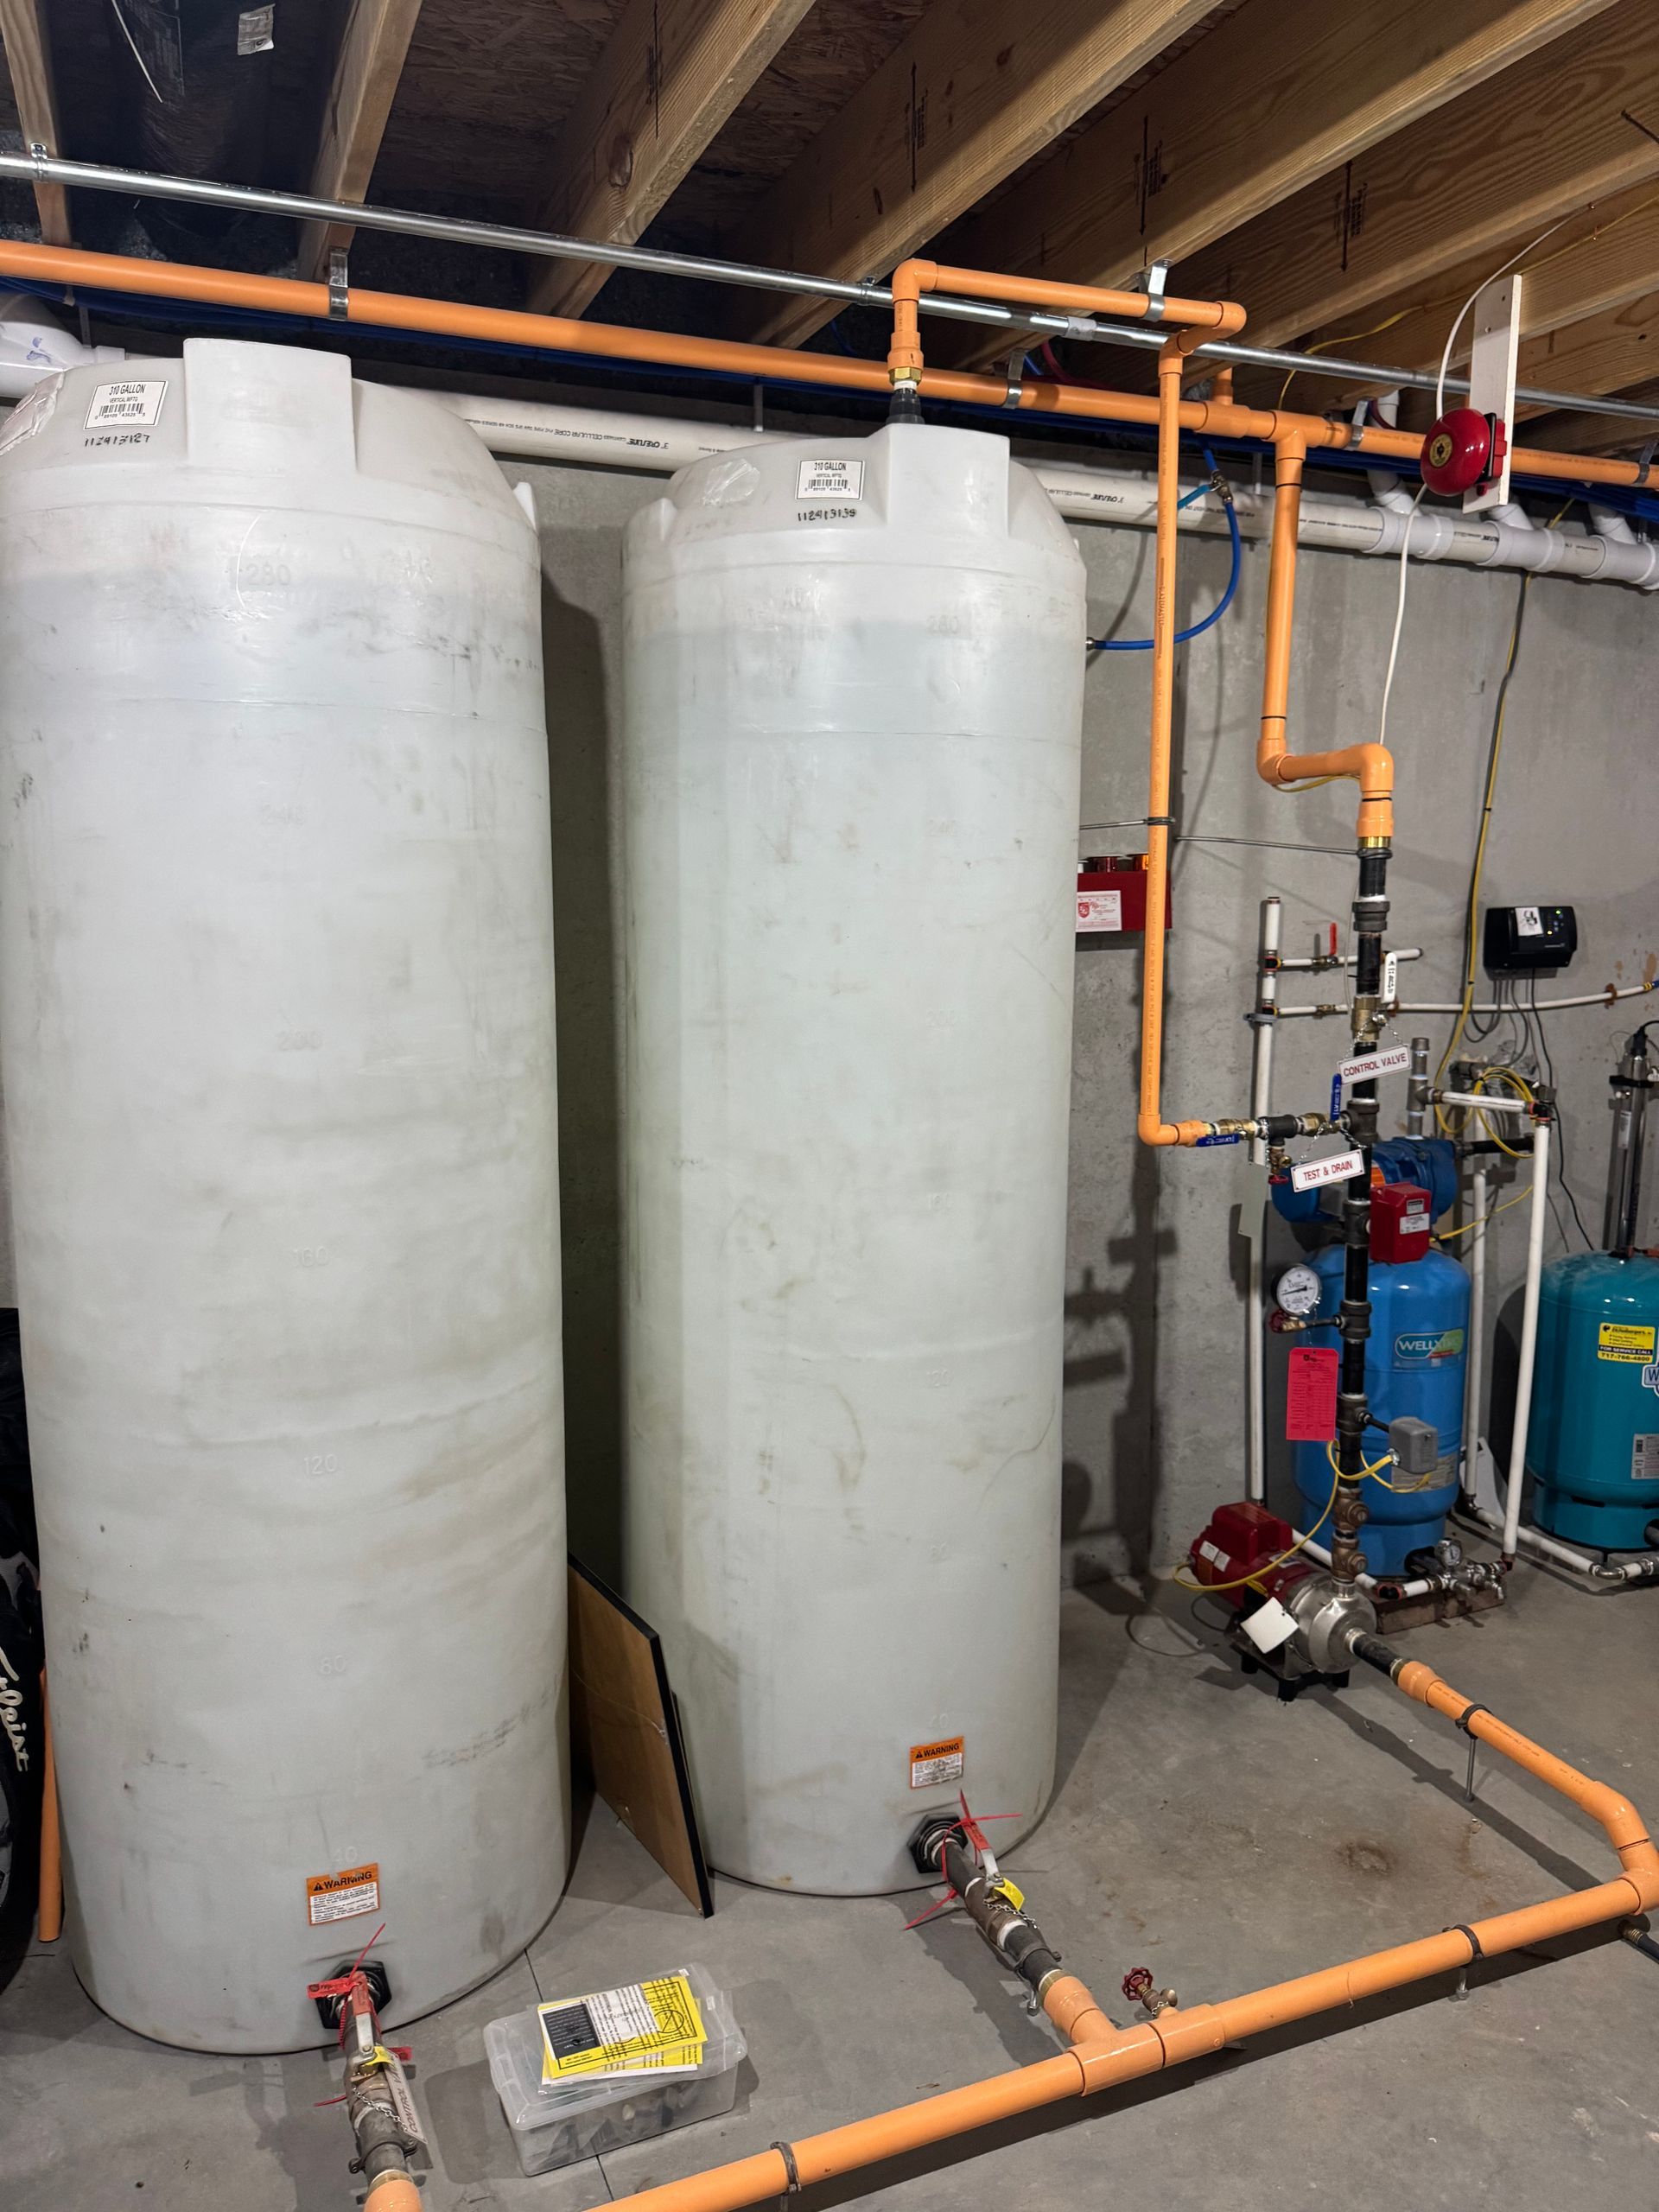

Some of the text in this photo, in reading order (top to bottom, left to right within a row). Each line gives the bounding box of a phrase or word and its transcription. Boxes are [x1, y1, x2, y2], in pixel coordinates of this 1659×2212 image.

[109, 384, 146, 396] 310 GALLON
[571, 431, 603, 441] CELLULAR
[823, 461, 847, 471] GALLON
[245, 563, 291, 587] 280
[1343, 1052, 1408, 1077] CONTROL VALVE
[1303, 1160, 1353, 1182] TEST & DRAIN
[292, 1246, 329, 1268] 160
[303, 1453, 339, 1476] 120
[923, 1742, 960, 1758] WARNING
[323, 1871, 372, 1890] WARNING
[398, 2088, 418, 2133] CONTROL
